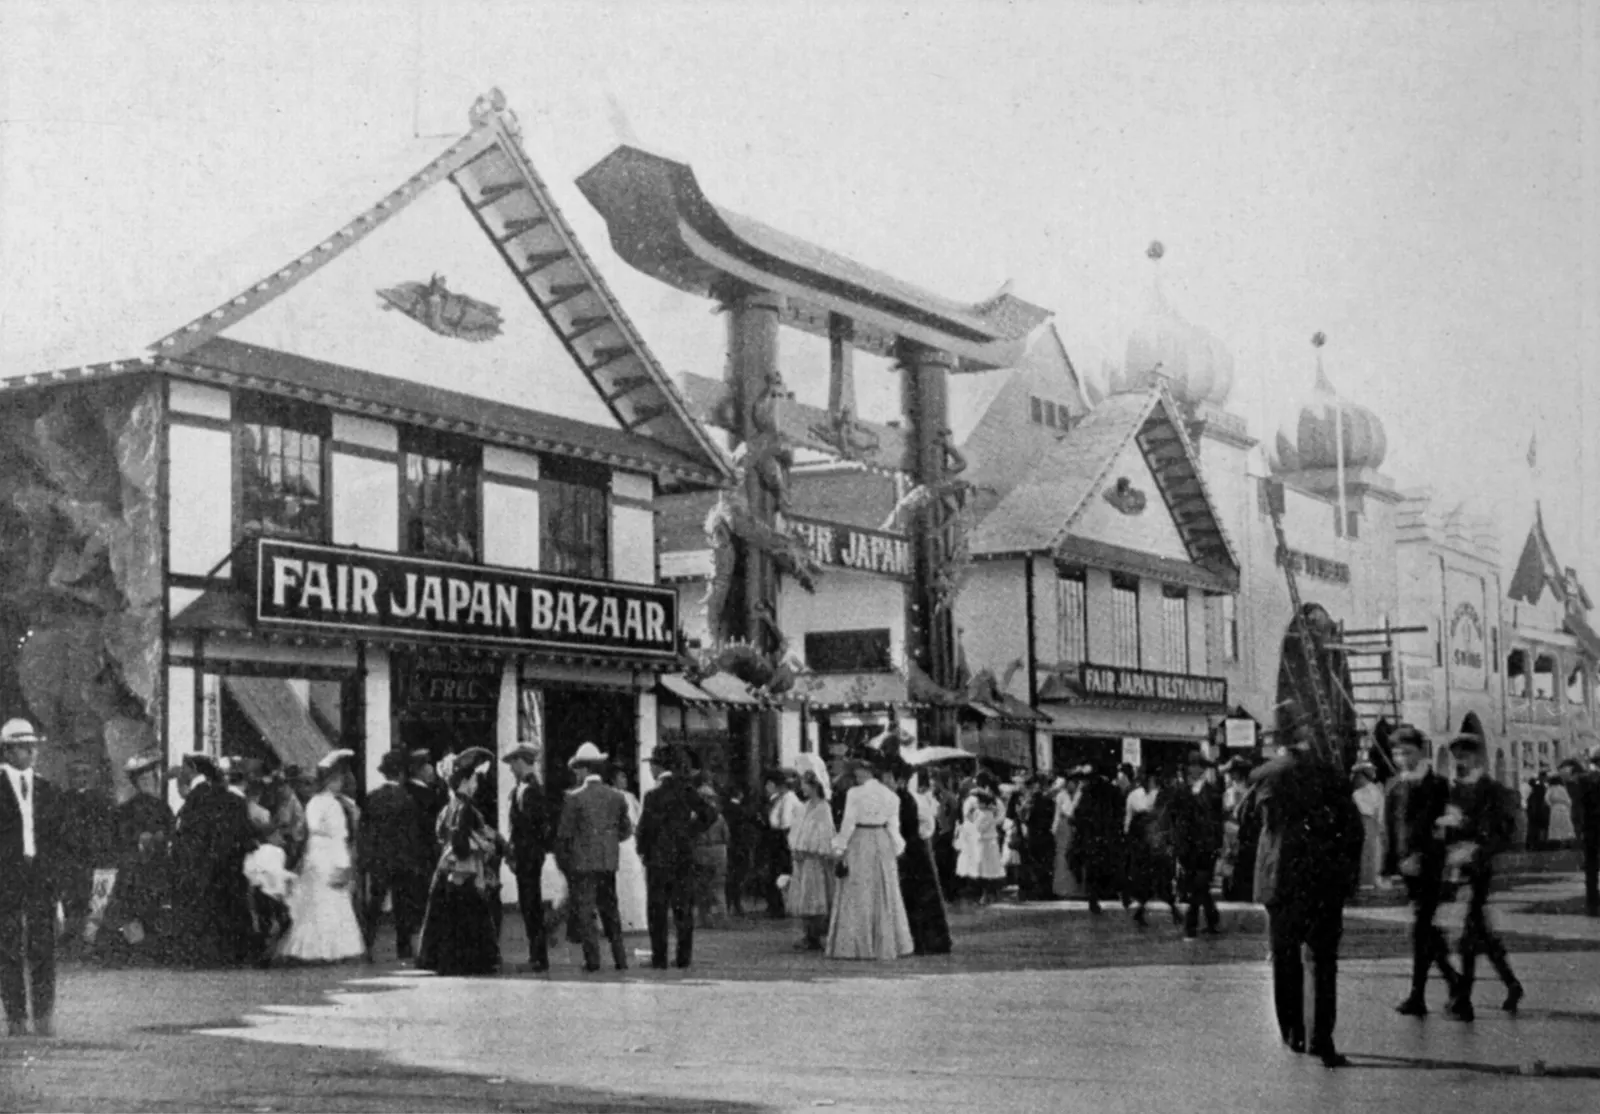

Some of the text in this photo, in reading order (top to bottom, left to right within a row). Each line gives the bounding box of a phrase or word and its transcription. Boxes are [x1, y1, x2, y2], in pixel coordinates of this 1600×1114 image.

[841, 532, 909, 574] JAPAN
[272, 556, 673, 642] FAIR JAPAN BAZAAR.
[1085, 668, 1225, 703] FAIR JAPAN RESTAURANT
